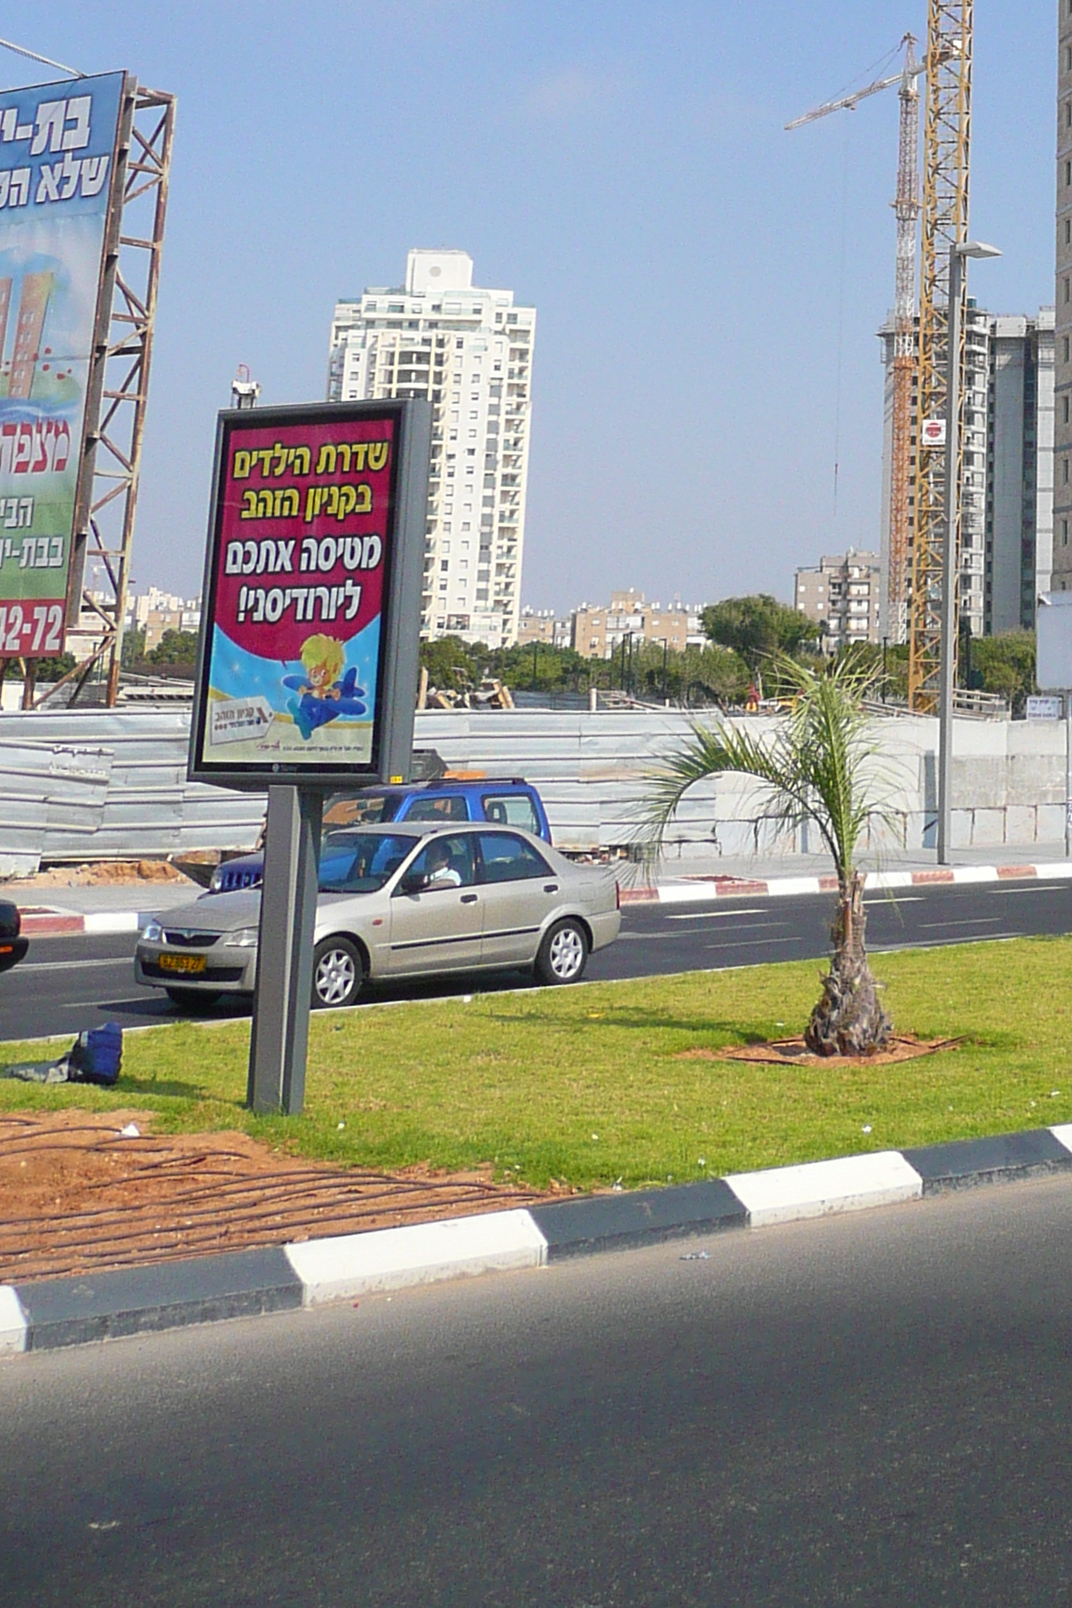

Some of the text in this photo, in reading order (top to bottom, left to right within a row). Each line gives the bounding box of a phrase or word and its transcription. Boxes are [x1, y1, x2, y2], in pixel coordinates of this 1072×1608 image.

[0, 96, 92, 155] בת-י
[36, 152, 110, 203] שלא
[232, 441, 389, 479] שדרת הילדים
[240, 483, 373, 522] בקניון הזהב
[0, 536, 64, 569] בבת-י
[224, 534, 383, 575] מטיסה אתכם
[237, 579, 362, 623] ליורודיסני!
